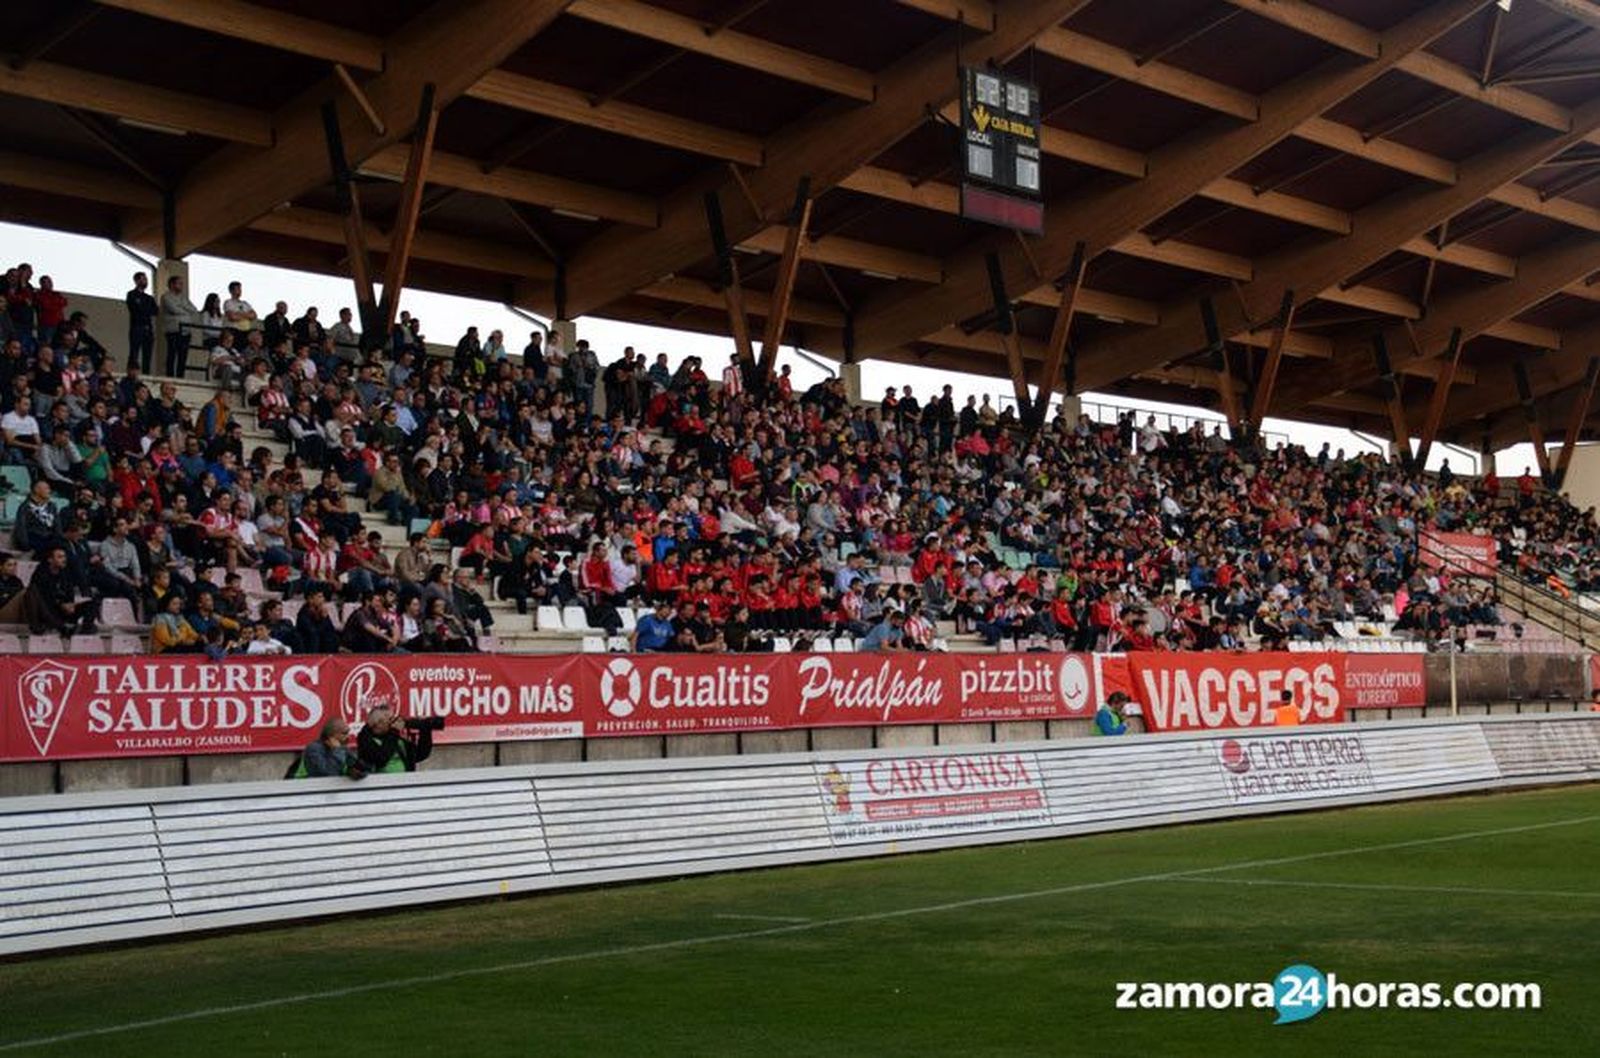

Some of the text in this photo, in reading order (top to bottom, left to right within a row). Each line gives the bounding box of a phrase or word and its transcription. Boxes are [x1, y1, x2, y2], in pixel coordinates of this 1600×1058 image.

[409, 667, 465, 682] eventos
[649, 665, 770, 708] Cualtis
[799, 655, 943, 721] Prialpán
[960, 658, 1054, 702] pizzbit
[1142, 662, 1340, 729] VACCEOS
[409, 685, 511, 717] MUCHO
[519, 678, 574, 713] MÁS
[116, 737, 192, 749] VILLARALBO
[865, 753, 1032, 796] CARTONISA
